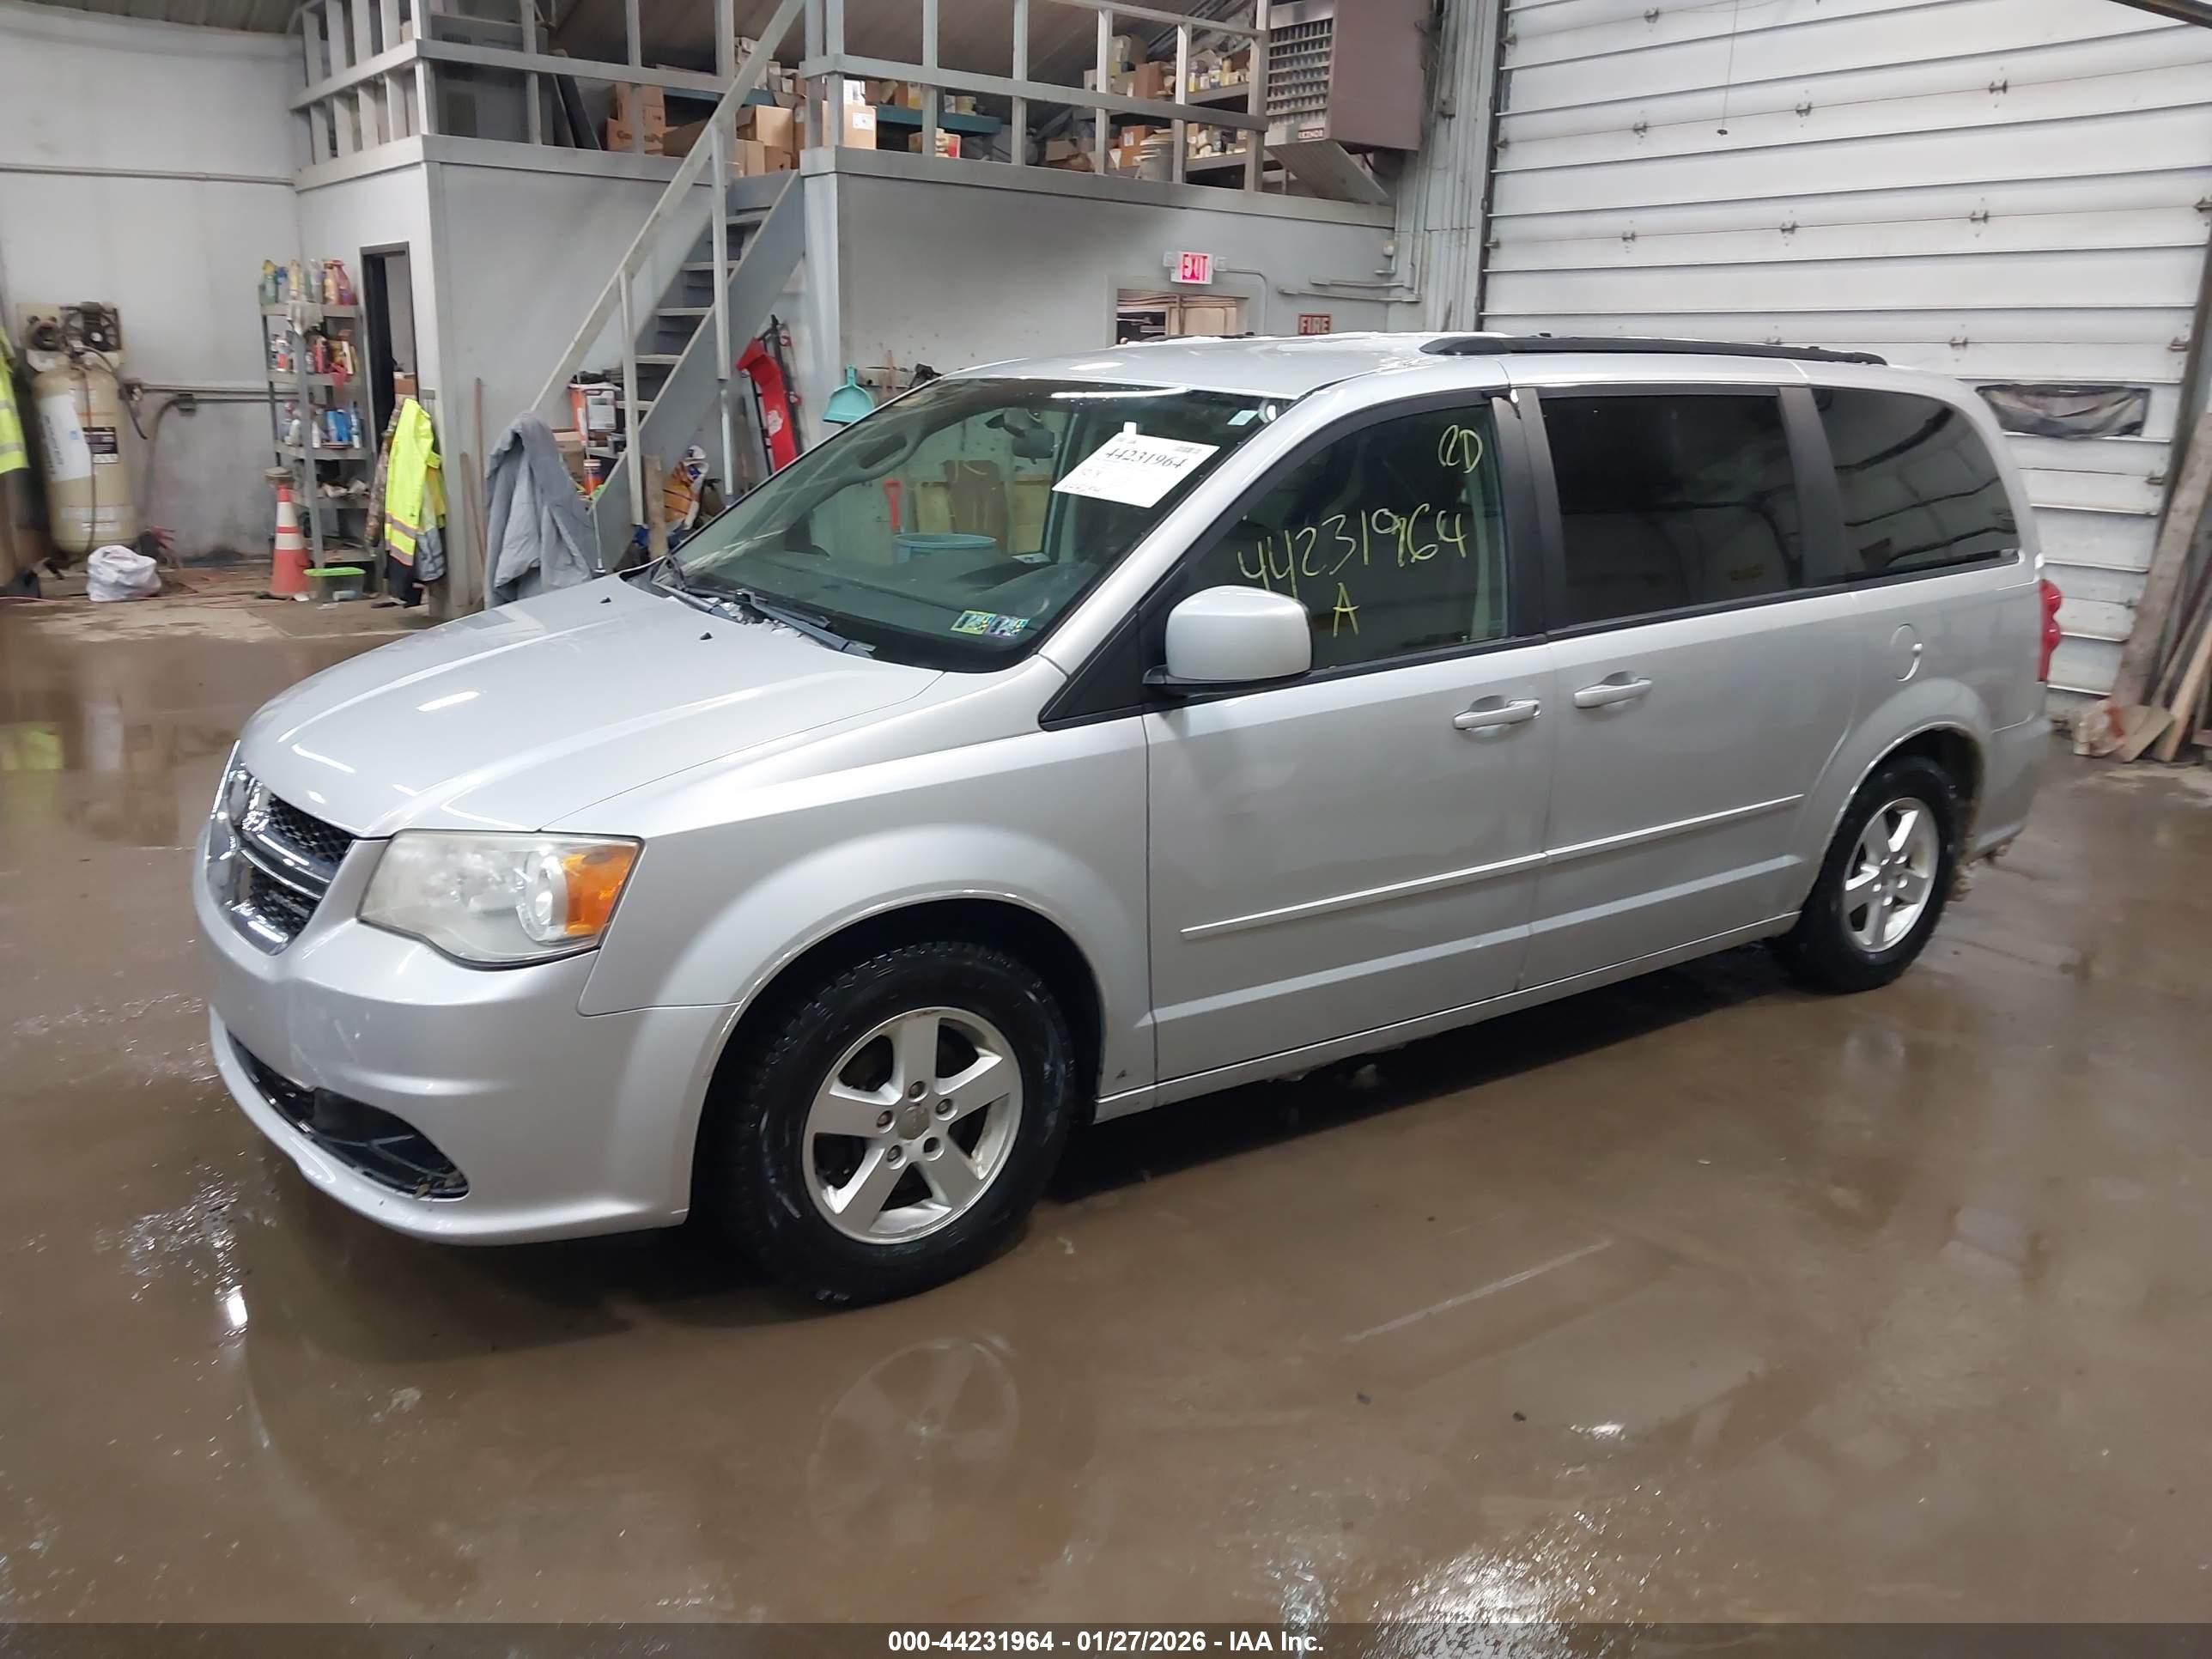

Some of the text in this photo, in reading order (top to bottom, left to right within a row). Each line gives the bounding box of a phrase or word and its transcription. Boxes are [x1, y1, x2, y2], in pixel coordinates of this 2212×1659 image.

[1182, 253, 1208, 282] EXIT
[1299, 316, 1330, 334] FIRE
[1104, 447, 1188, 469] 44231964
[1237, 502, 1468, 599] 44231964
[1332, 581, 1360, 637] A
